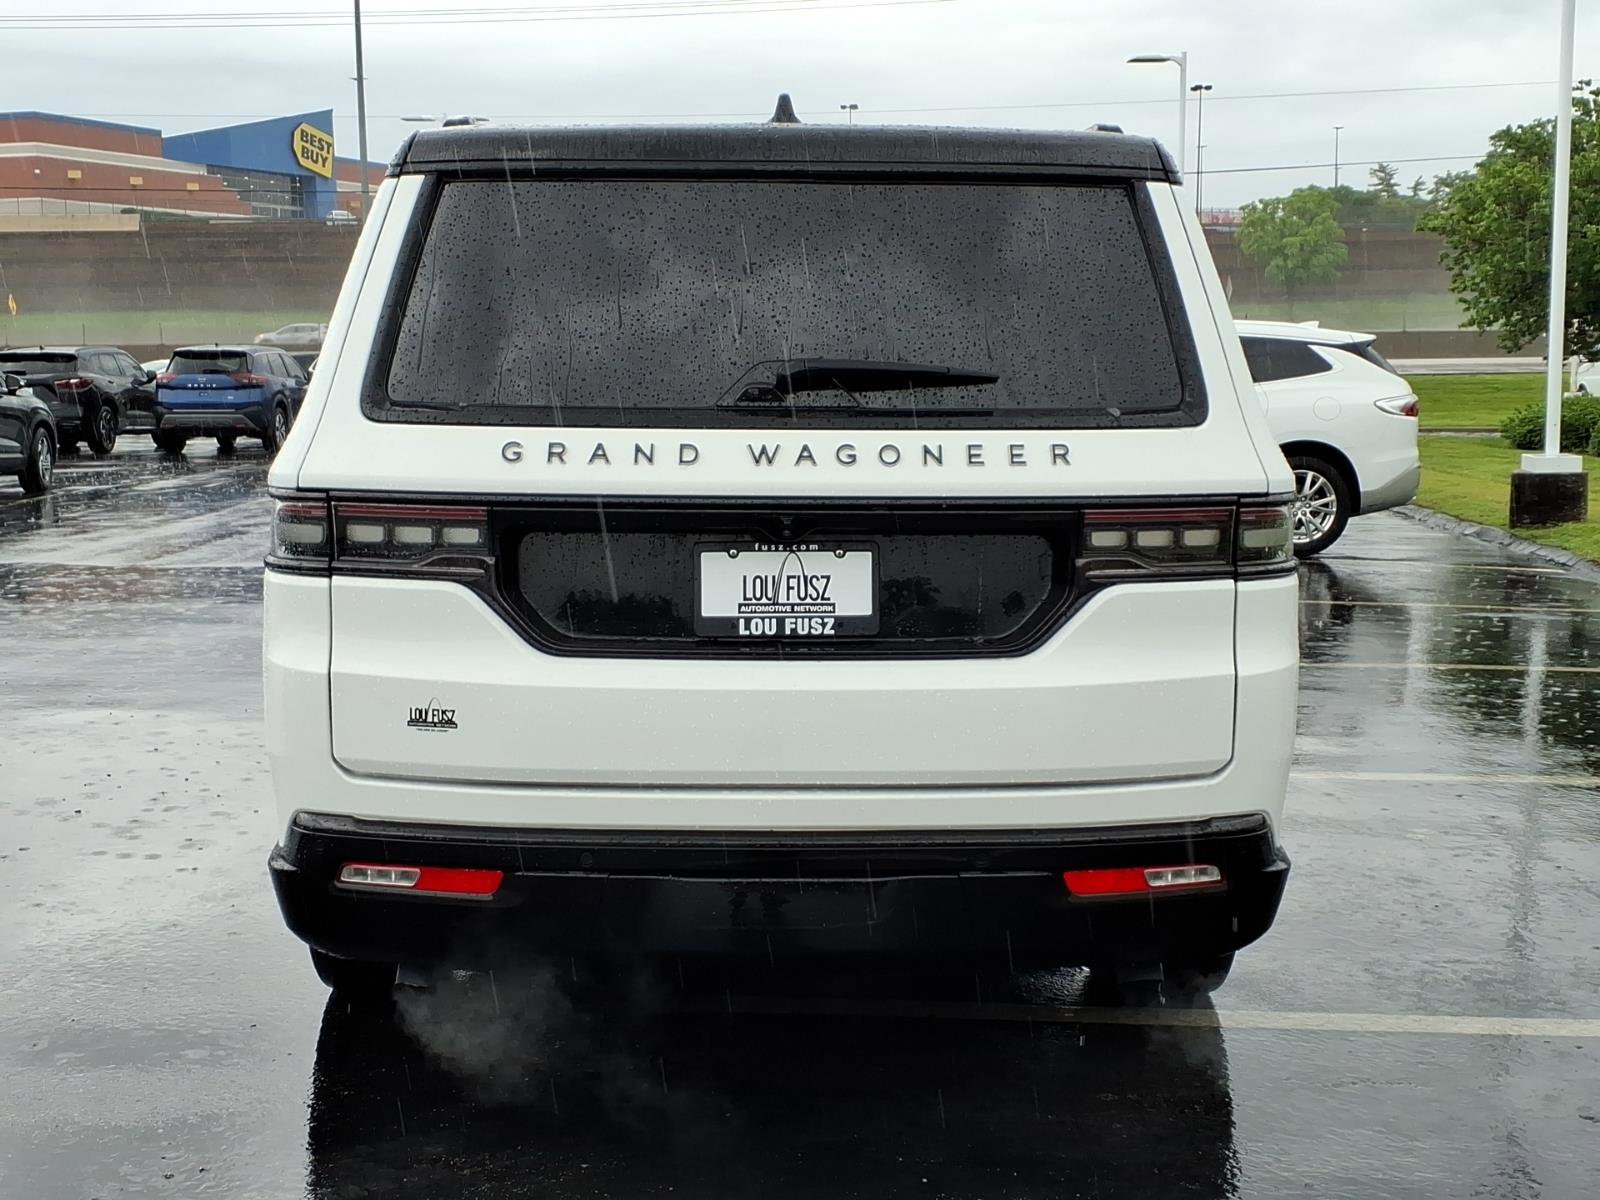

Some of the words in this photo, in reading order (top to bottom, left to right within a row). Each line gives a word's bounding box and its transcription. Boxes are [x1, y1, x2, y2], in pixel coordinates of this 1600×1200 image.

[300, 128, 332, 155] BEST
[301, 145, 329, 168] BUY
[500, 441, 700, 466] GRAND
[748, 443, 1072, 467] WAGONEER
[754, 542, 819, 551] fusz.com
[742, 575, 776, 602] LOU
[786, 575, 831, 602] FUSZ
[739, 618, 777, 636] LOU
[785, 617, 835, 636] FUSZ
[409, 707, 427, 722] LOU
[432, 708, 455, 724] FUSZ
